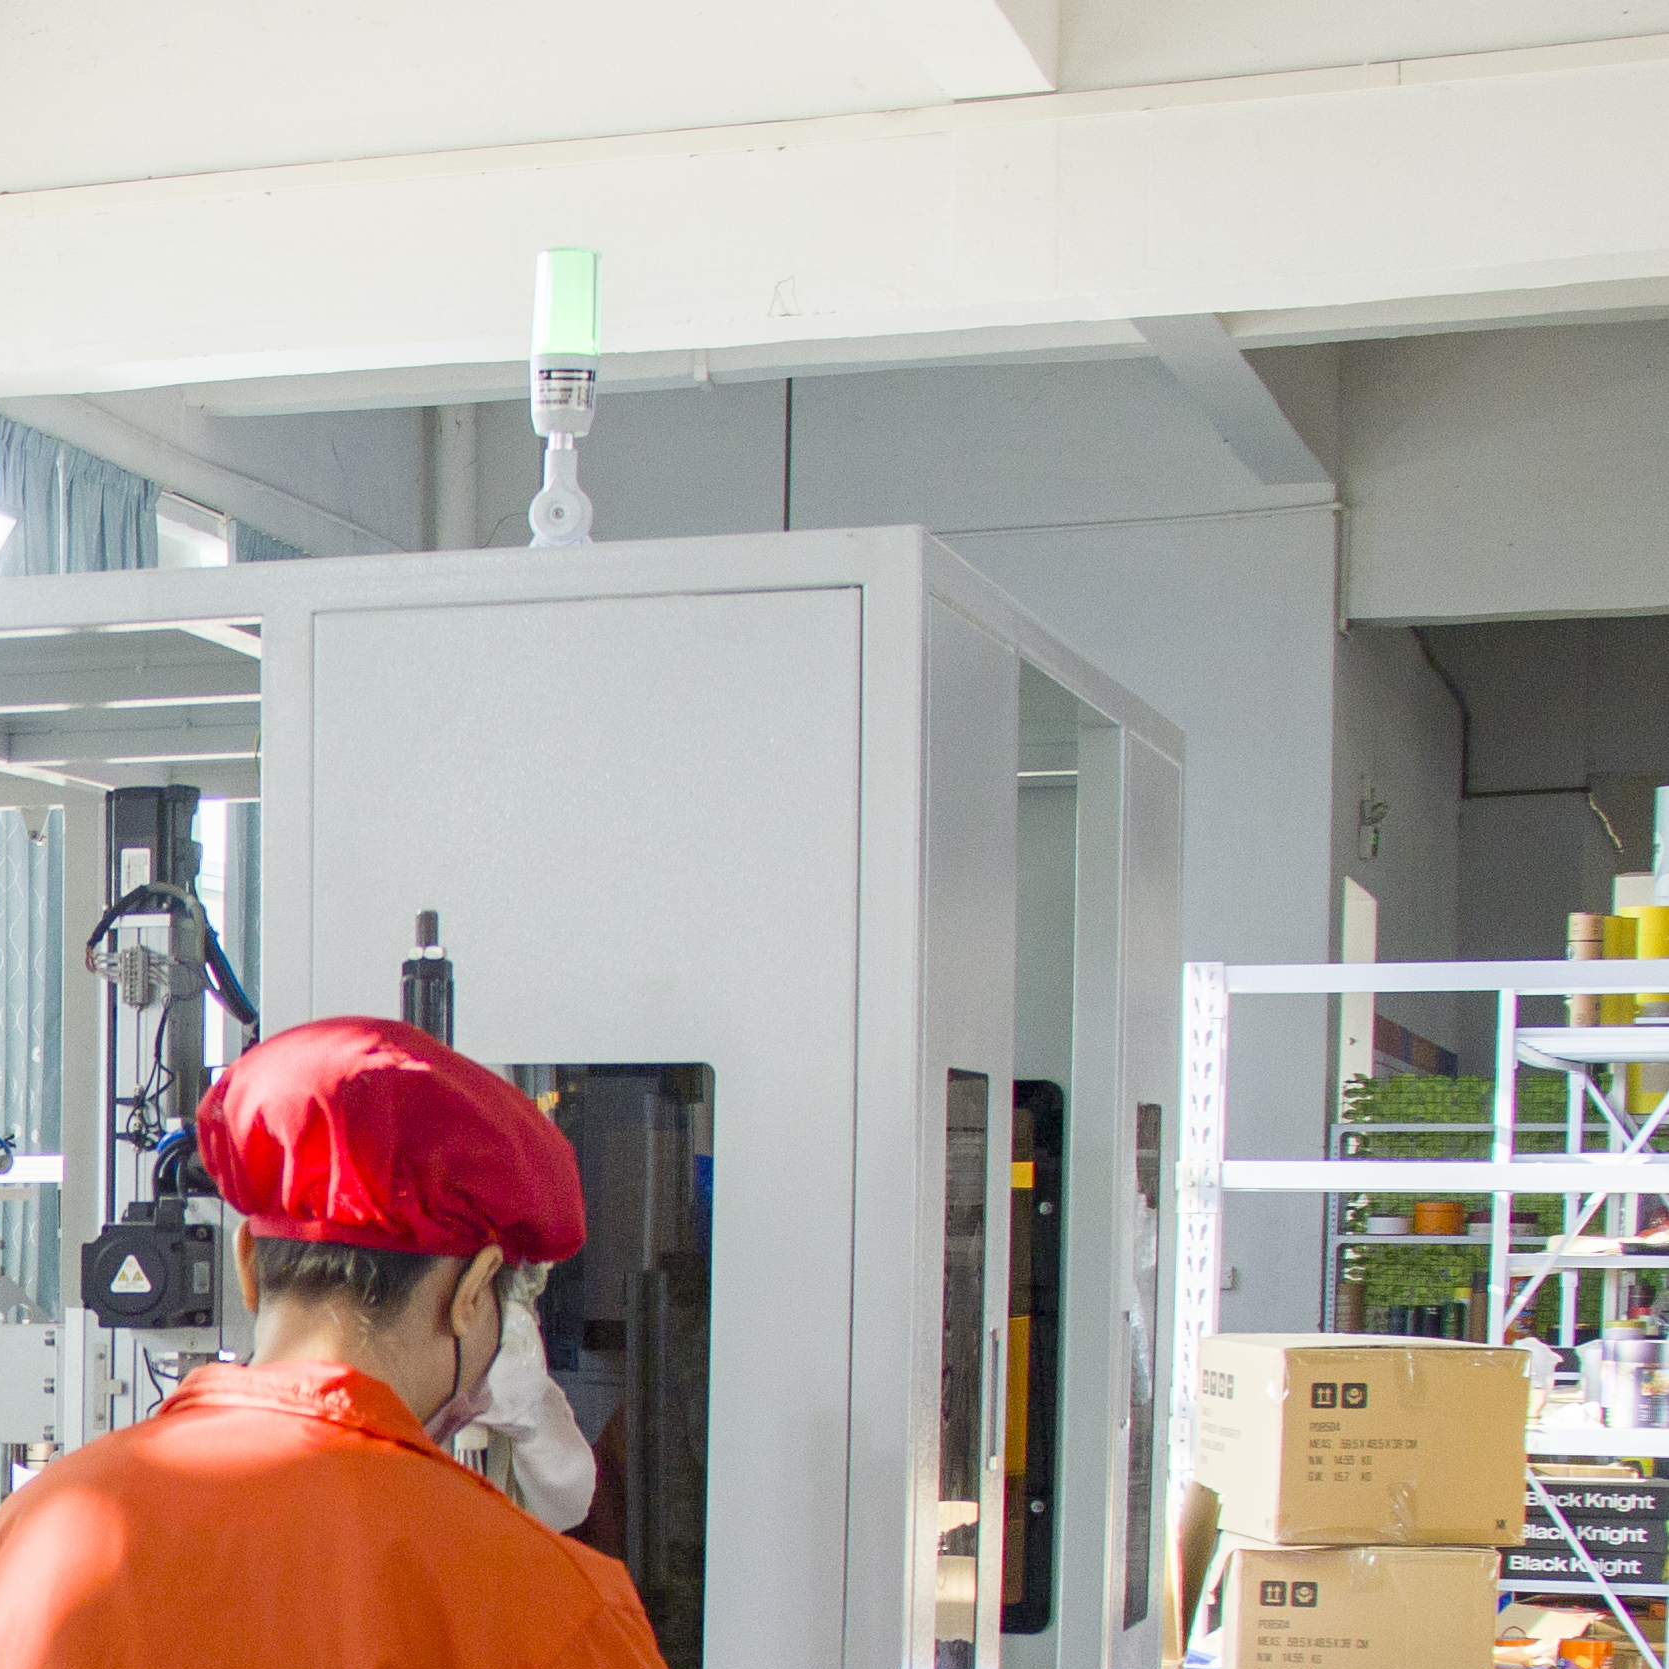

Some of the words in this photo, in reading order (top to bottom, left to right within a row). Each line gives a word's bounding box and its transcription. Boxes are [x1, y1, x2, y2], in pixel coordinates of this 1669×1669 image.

[1583, 1493, 1657, 1512] Knight
[1521, 1523, 1569, 1540] Blac
[1575, 1526, 1649, 1546] Knight
[1509, 1555, 1568, 1572] Black
